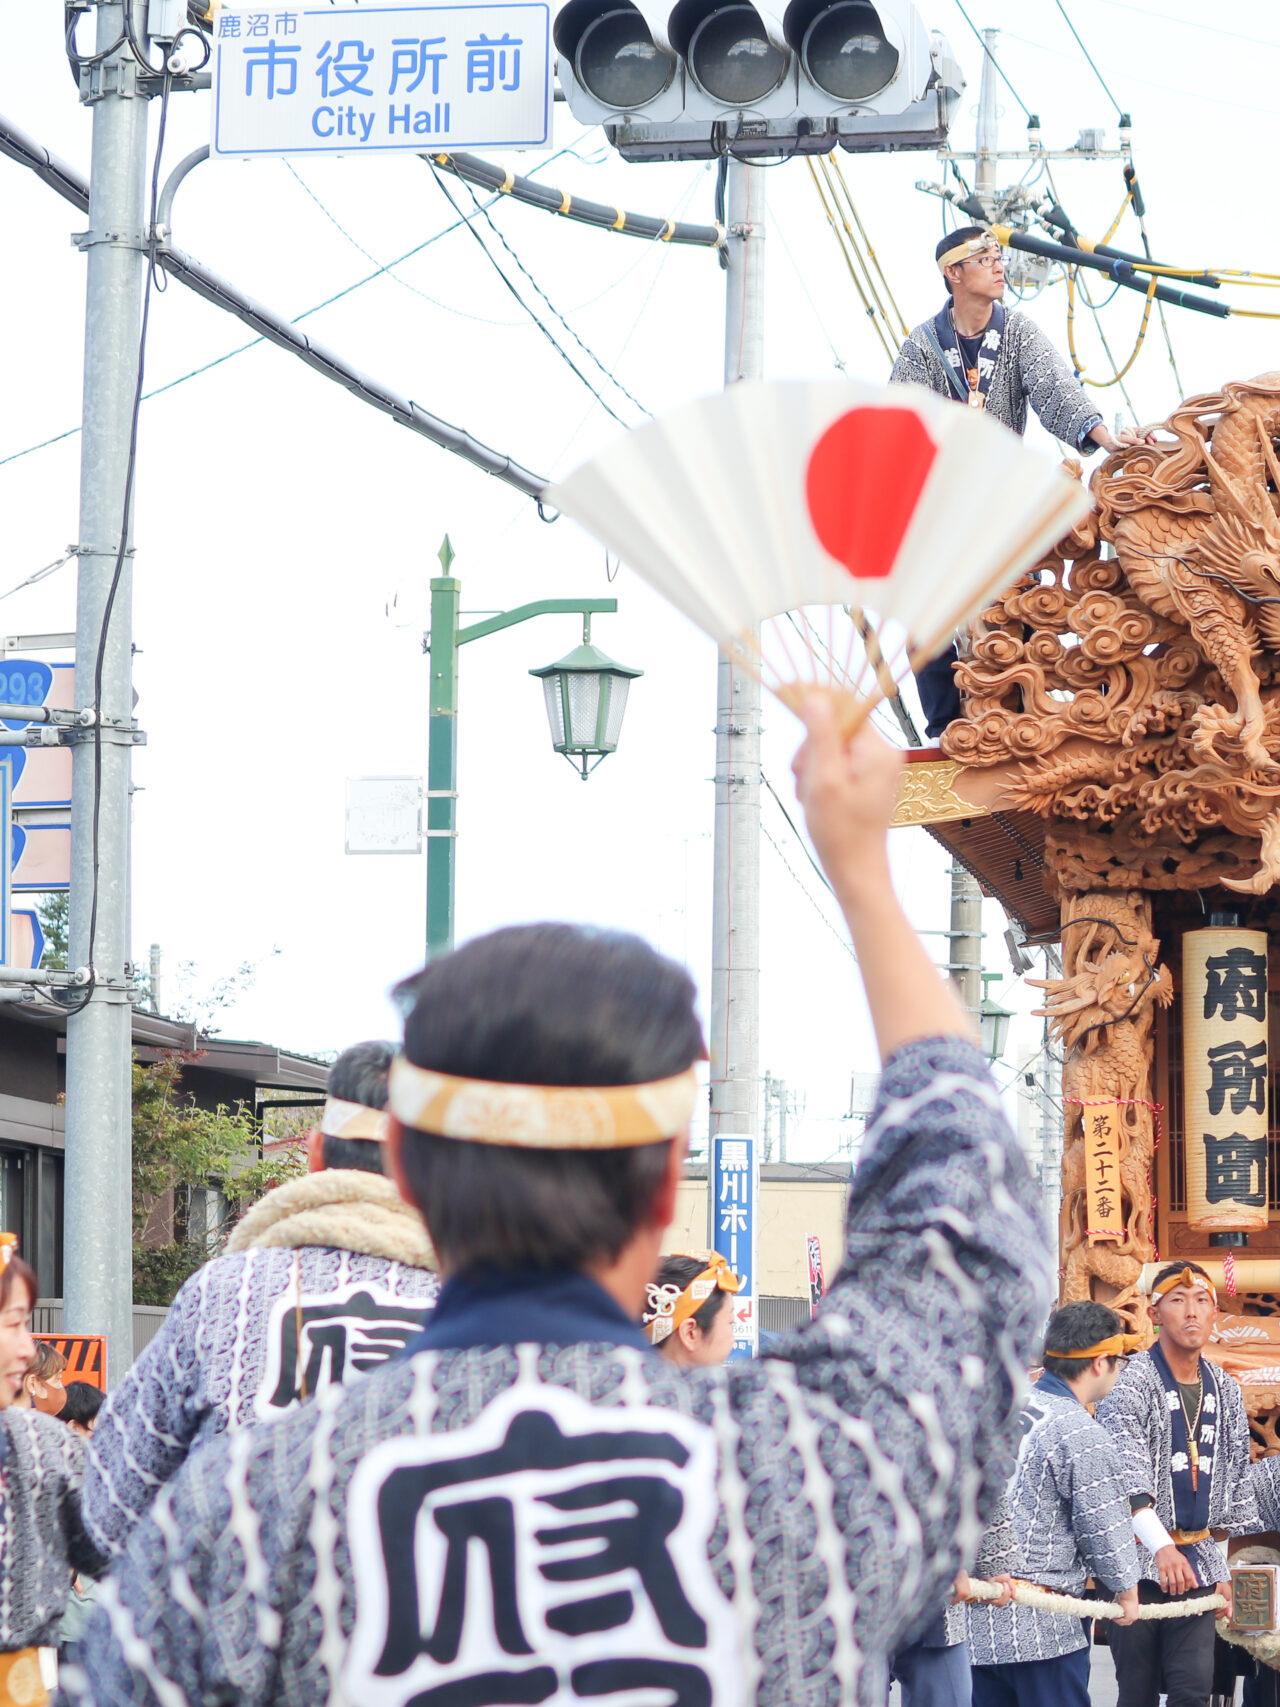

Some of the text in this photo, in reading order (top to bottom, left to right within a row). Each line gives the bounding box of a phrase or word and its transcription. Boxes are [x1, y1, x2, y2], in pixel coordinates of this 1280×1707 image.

[217, 11, 299, 39] 鹿沼市
[243, 32, 525, 100] 市役所前
[311, 102, 451, 143] City Hall
[1203, 946, 1268, 1208] 府所町
[1091, 1114, 1116, 1218] 第二十二番
